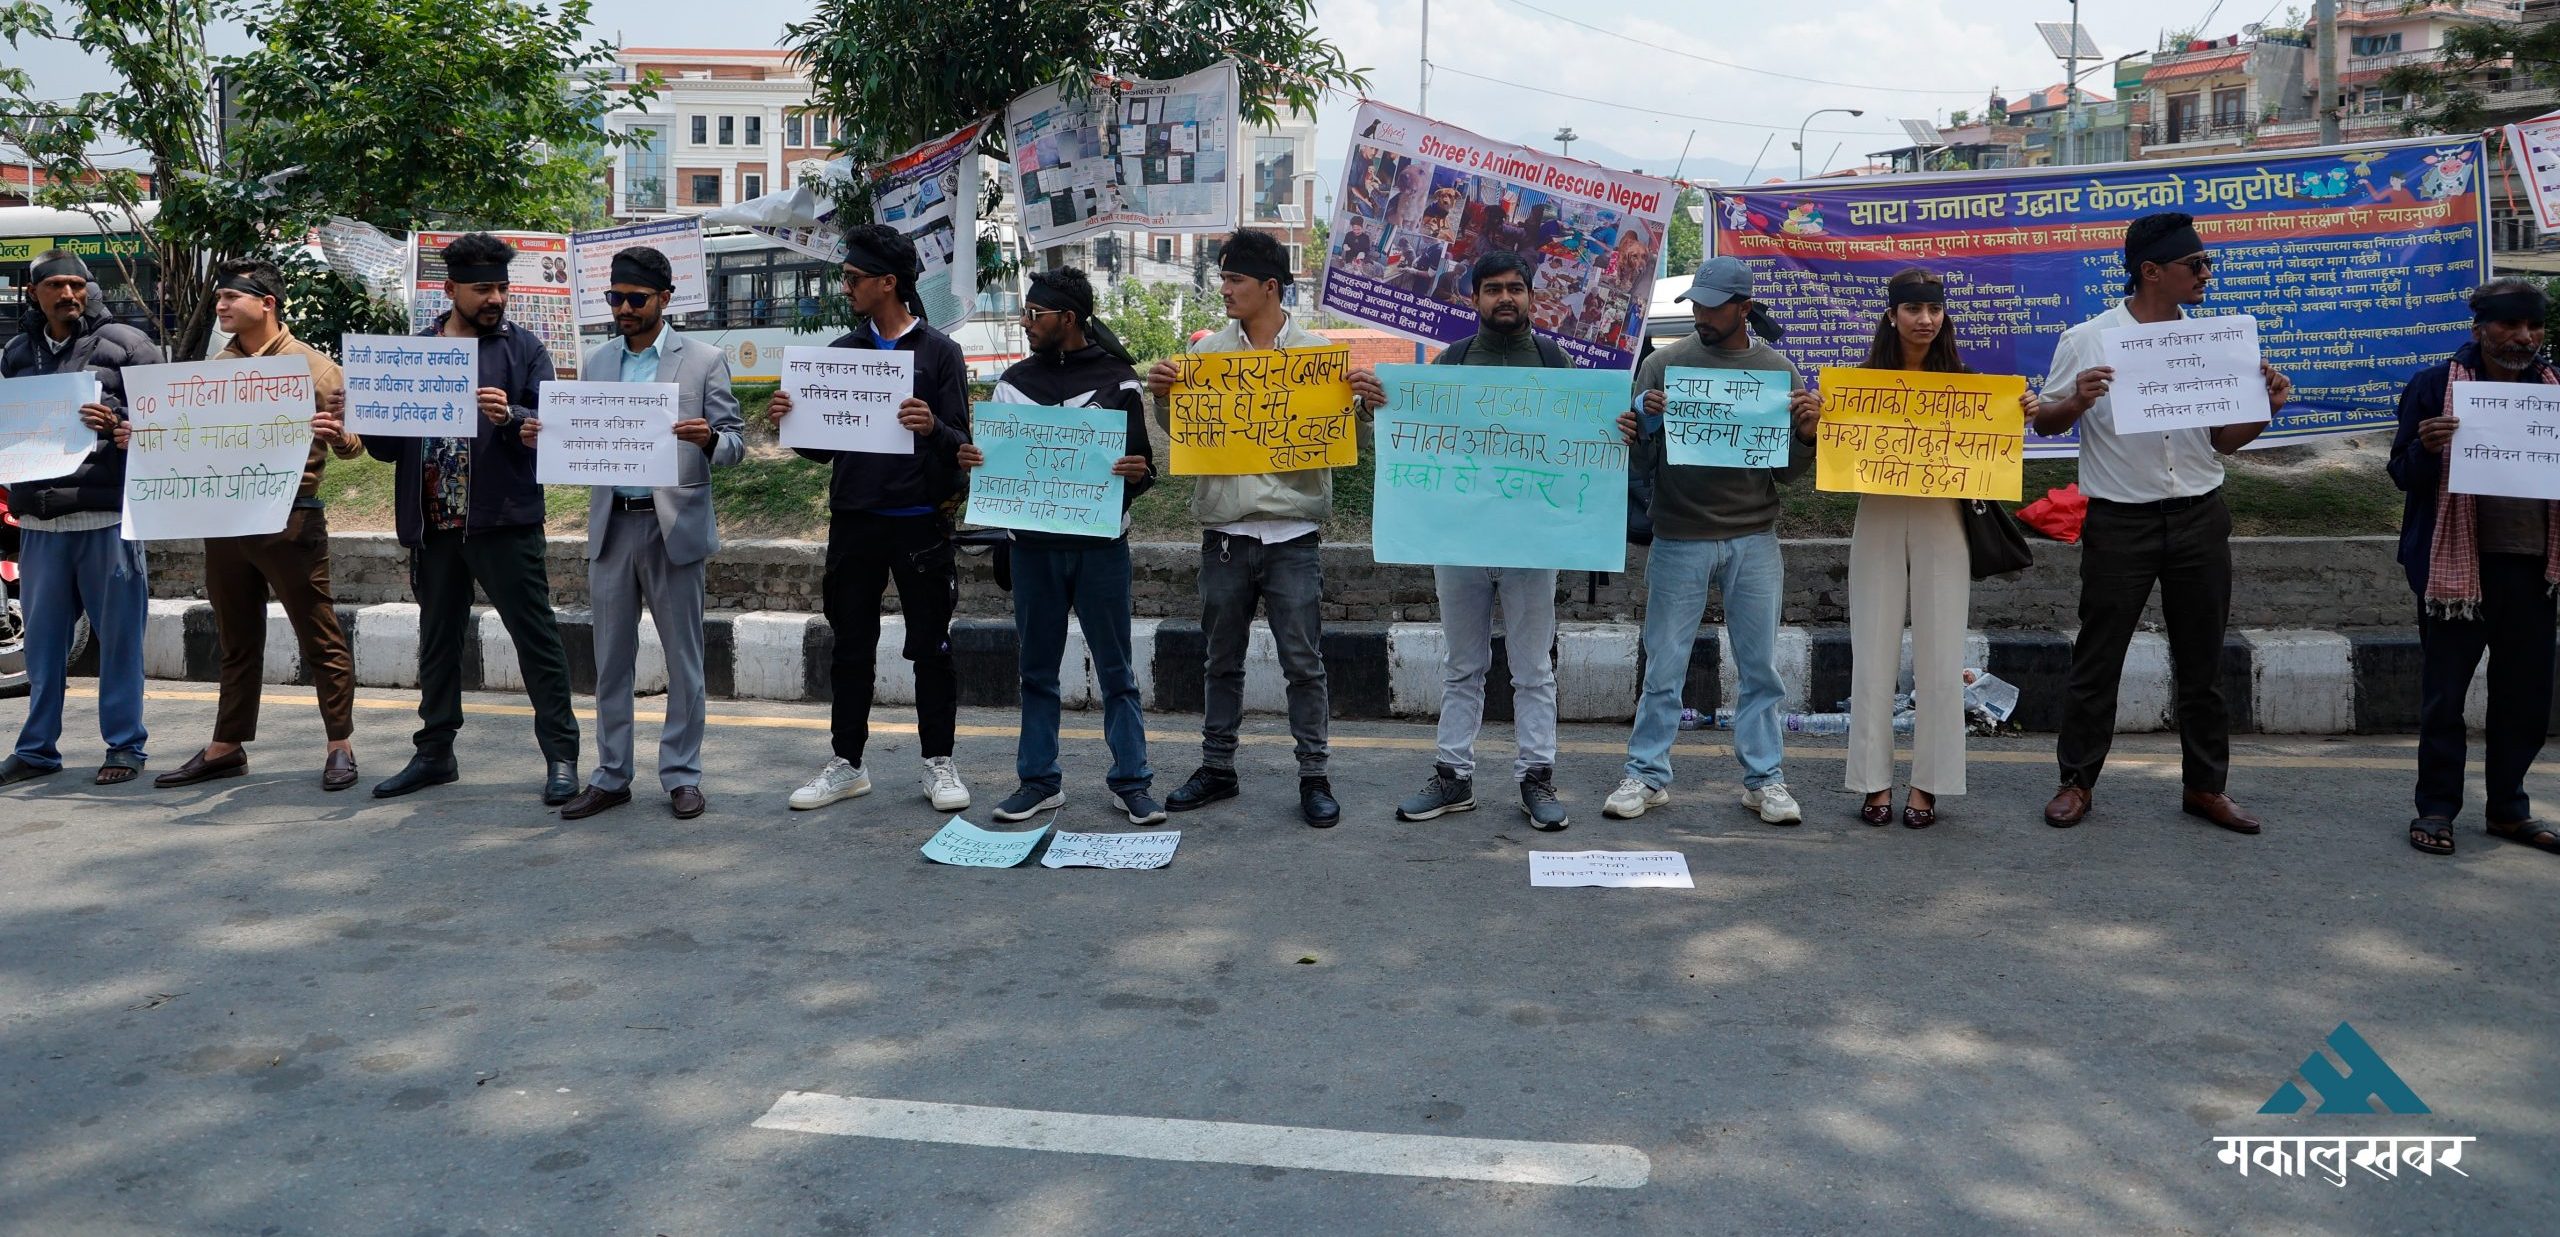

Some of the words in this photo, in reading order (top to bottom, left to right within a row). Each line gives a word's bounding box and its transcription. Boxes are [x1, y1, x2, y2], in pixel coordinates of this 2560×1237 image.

[1418, 133, 1480, 167] Shree's
[1480, 151, 1545, 181] Animal
[1544, 165, 1606, 199] Rescue
[1606, 180, 1661, 215] Nepal
[1847, 200, 1909, 225] सारा
[1913, 193, 2007, 221] जनावर
[2086, 173, 2186, 210] केन्द्रको
[2193, 167, 2296, 210] अनुरोध
[2227, 219, 2253, 233] तथा
[2257, 212, 2295, 231] गरिमा
[2300, 210, 2345, 230] संरक्षण
[1739, 231, 1784, 248] नेपालको
[1826, 242, 1847, 259] पशु
[1849, 235, 1895, 254] सम्बन्धी
[1898, 237, 1932, 257] कानुन
[1936, 230, 1970, 256] पुरानो
[1973, 234, 1980, 248] र
[1982, 227, 2028, 247] कमजोर
[2052, 223, 2078, 244] नयाँ
[2352, 240, 2373, 251] कडा
[2375, 235, 2416, 248] निगरानी
[2287, 256, 2324, 268] जोडदार
[2327, 256, 2346, 266] माग
[2283, 285, 2301, 298] पनि
[2347, 284, 2367, 294] माग
[1973, 300, 1991, 310] कडा
[2301, 301, 2336, 312] अवस्था
[1786, 336, 1822, 344] यातायात
[2120, 338, 2153, 351] मानव
[2158, 332, 2206, 349] अधिकार
[2209, 327, 2244, 341] आयोग
[348, 345, 371, 363] जेन्जी
[375, 346, 423, 367] आन्दोलन
[427, 348, 470, 365] सम्बन्धि
[2300, 347, 2320, 356] माग
[790, 361, 811, 372] सत्य
[816, 362, 858, 377] लुकाउन
[167, 375, 228, 408] महिना
[374, 374, 414, 392] अधिकार
[419, 375, 469, 393] आयोगको
[800, 384, 848, 401] प्रतिवेदन
[852, 391, 891, 402] दबाउन
[1666, 379, 1713, 399] न्याय
[2137, 382, 2168, 396] जेन्जि
[2173, 374, 2239, 393] आन्दोलनको
[549, 392, 576, 405] जेन्जि
[580, 393, 624, 406] आन्दोलन
[628, 394, 669, 407] सम्बन्धी
[1235, 387, 1255, 422] हो
[1261, 382, 1294, 419] भने
[1393, 382, 1466, 415] जनता
[1825, 378, 1915, 415] जनताको
[2469, 397, 2509, 409] मानव
[355, 401, 389, 419] छानबिन
[392, 402, 437, 423] प्रतिवेदन
[442, 402, 453, 421] खै
[2143, 402, 2192, 419] प्रतिवेदन
[2197, 398, 2231, 417] हरायो
[2288, 411, 2341, 426] जनचेतना
[571, 418, 599, 428] मानव
[604, 416, 646, 429] अधिकार
[974, 414, 1020, 438] जनताको
[131, 423, 167, 453] पनि
[201, 424, 253, 449] मानव
[562, 437, 608, 450] आयोगको
[612, 438, 654, 451] प्रतिवेदन
[1667, 421, 1743, 447] सडकमा
[1820, 422, 1872, 451] मन्दा
[1391, 421, 1460, 455] मानव
[1462, 424, 1552, 464] अधिकार
[1555, 429, 1629, 471] आयोग
[2464, 444, 2521, 462] प्रतिवेदन
[568, 459, 620, 472] सार्वजनिक
[624, 463, 639, 472] गर
[1856, 455, 1913, 487] शक्ति
[973, 471, 1040, 497] जनताको
[1028, 500, 1058, 519] पनि
